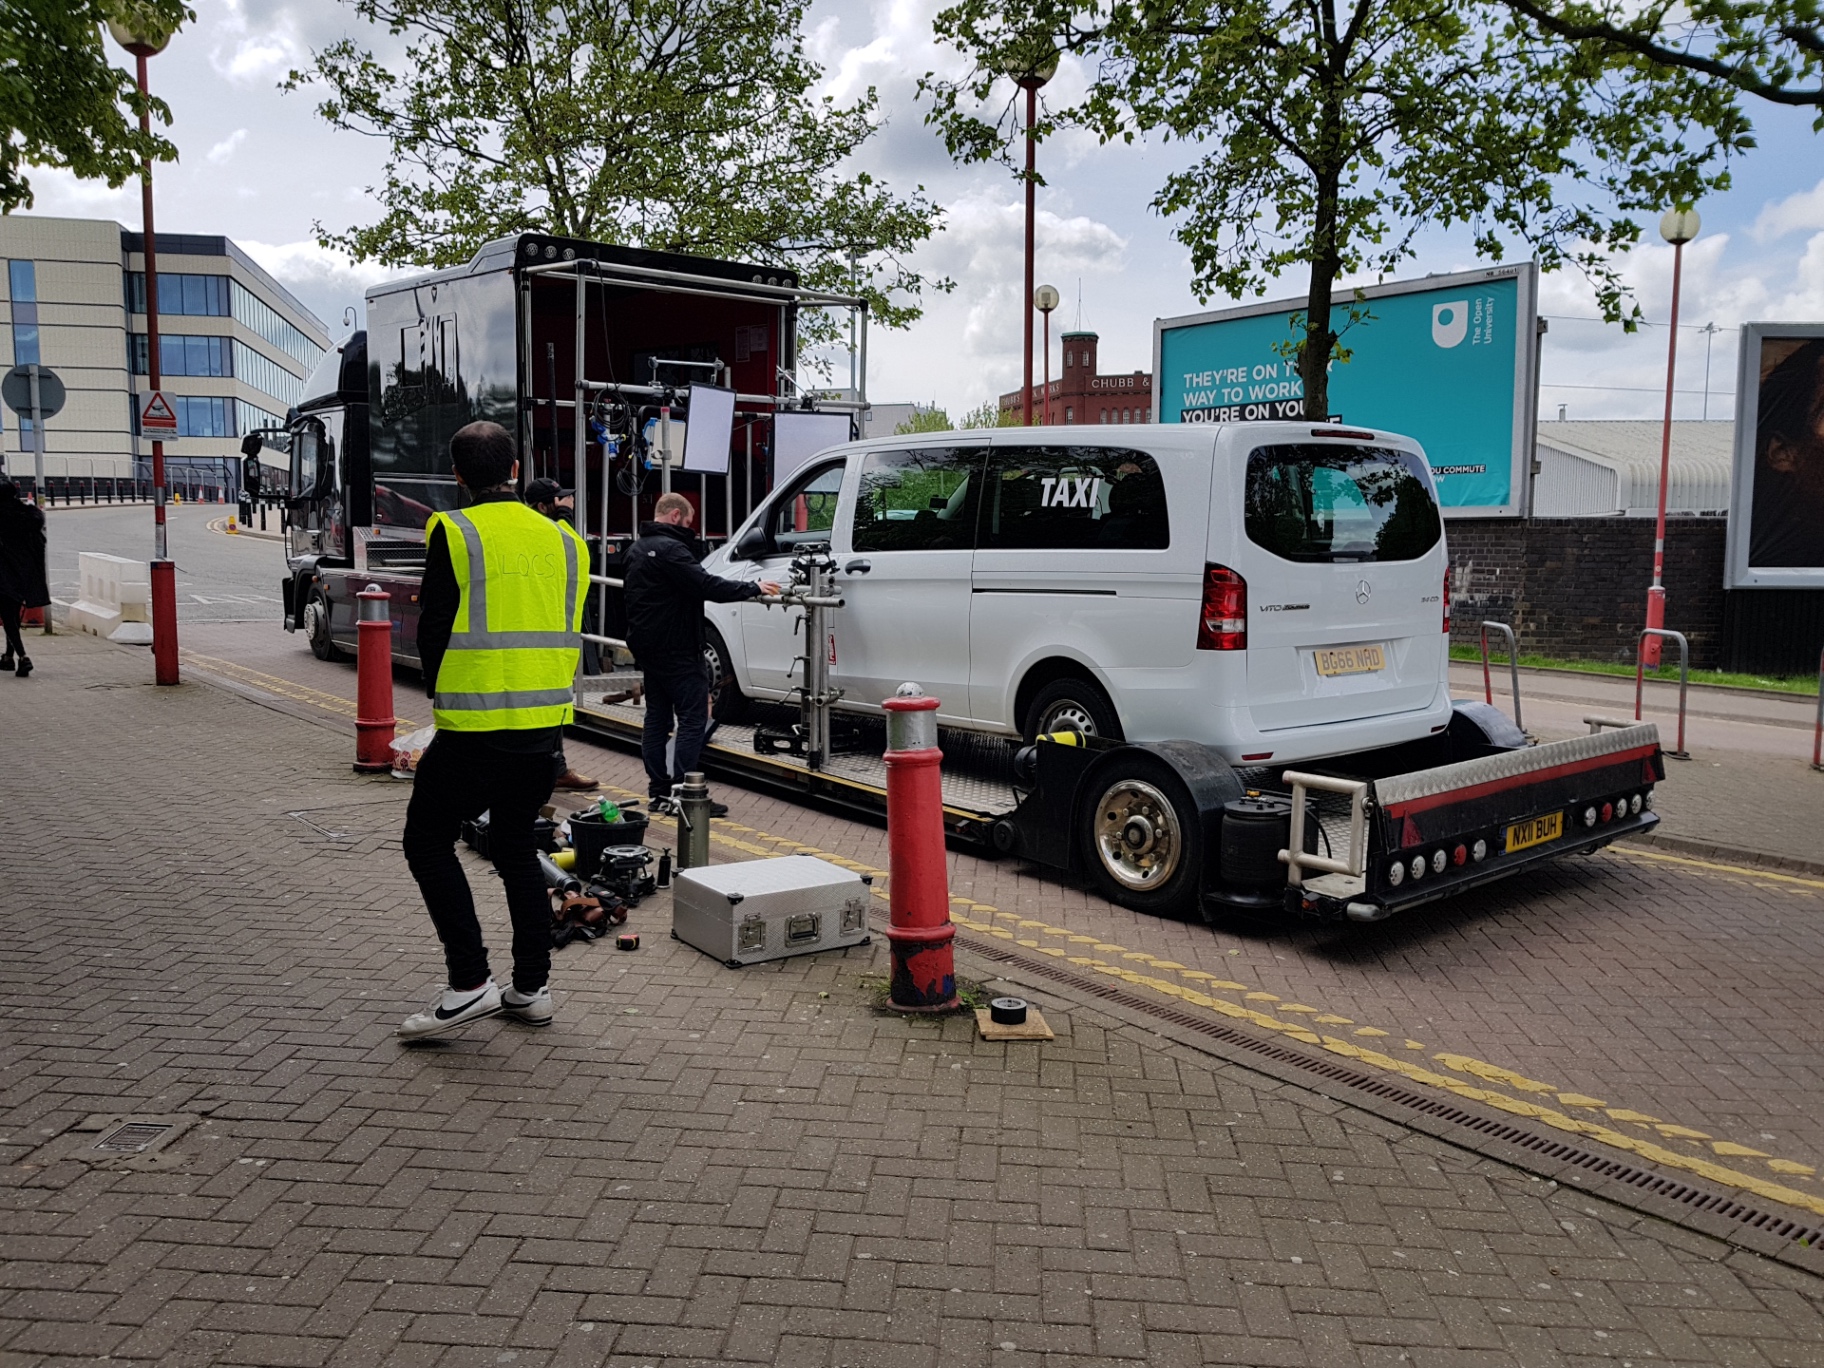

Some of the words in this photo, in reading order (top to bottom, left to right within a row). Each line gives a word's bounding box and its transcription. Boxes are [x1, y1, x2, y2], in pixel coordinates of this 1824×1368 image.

[1473, 298, 1482, 324] Open
[1483, 297, 1495, 344] University
[1472, 327, 1481, 345] The
[1091, 377, 1134, 389] CHUBB
[1142, 377, 1150, 387] &
[1183, 366, 1248, 388] THEY'RE
[1252, 363, 1278, 381] ON
[1183, 389, 1217, 407] WAY
[1221, 387, 1243, 403] TO
[1248, 380, 1303, 400] WORK
[1182, 406, 1240, 423] YOU'RE
[1245, 403, 1270, 420] ON
[1443, 465, 1485, 474] COMMUTE
[1041, 477, 1100, 508] TAXI
[1320, 651, 1354, 671] BG66
[1512, 822, 1534, 847] NX11
[1536, 815, 1557, 840] BUH
